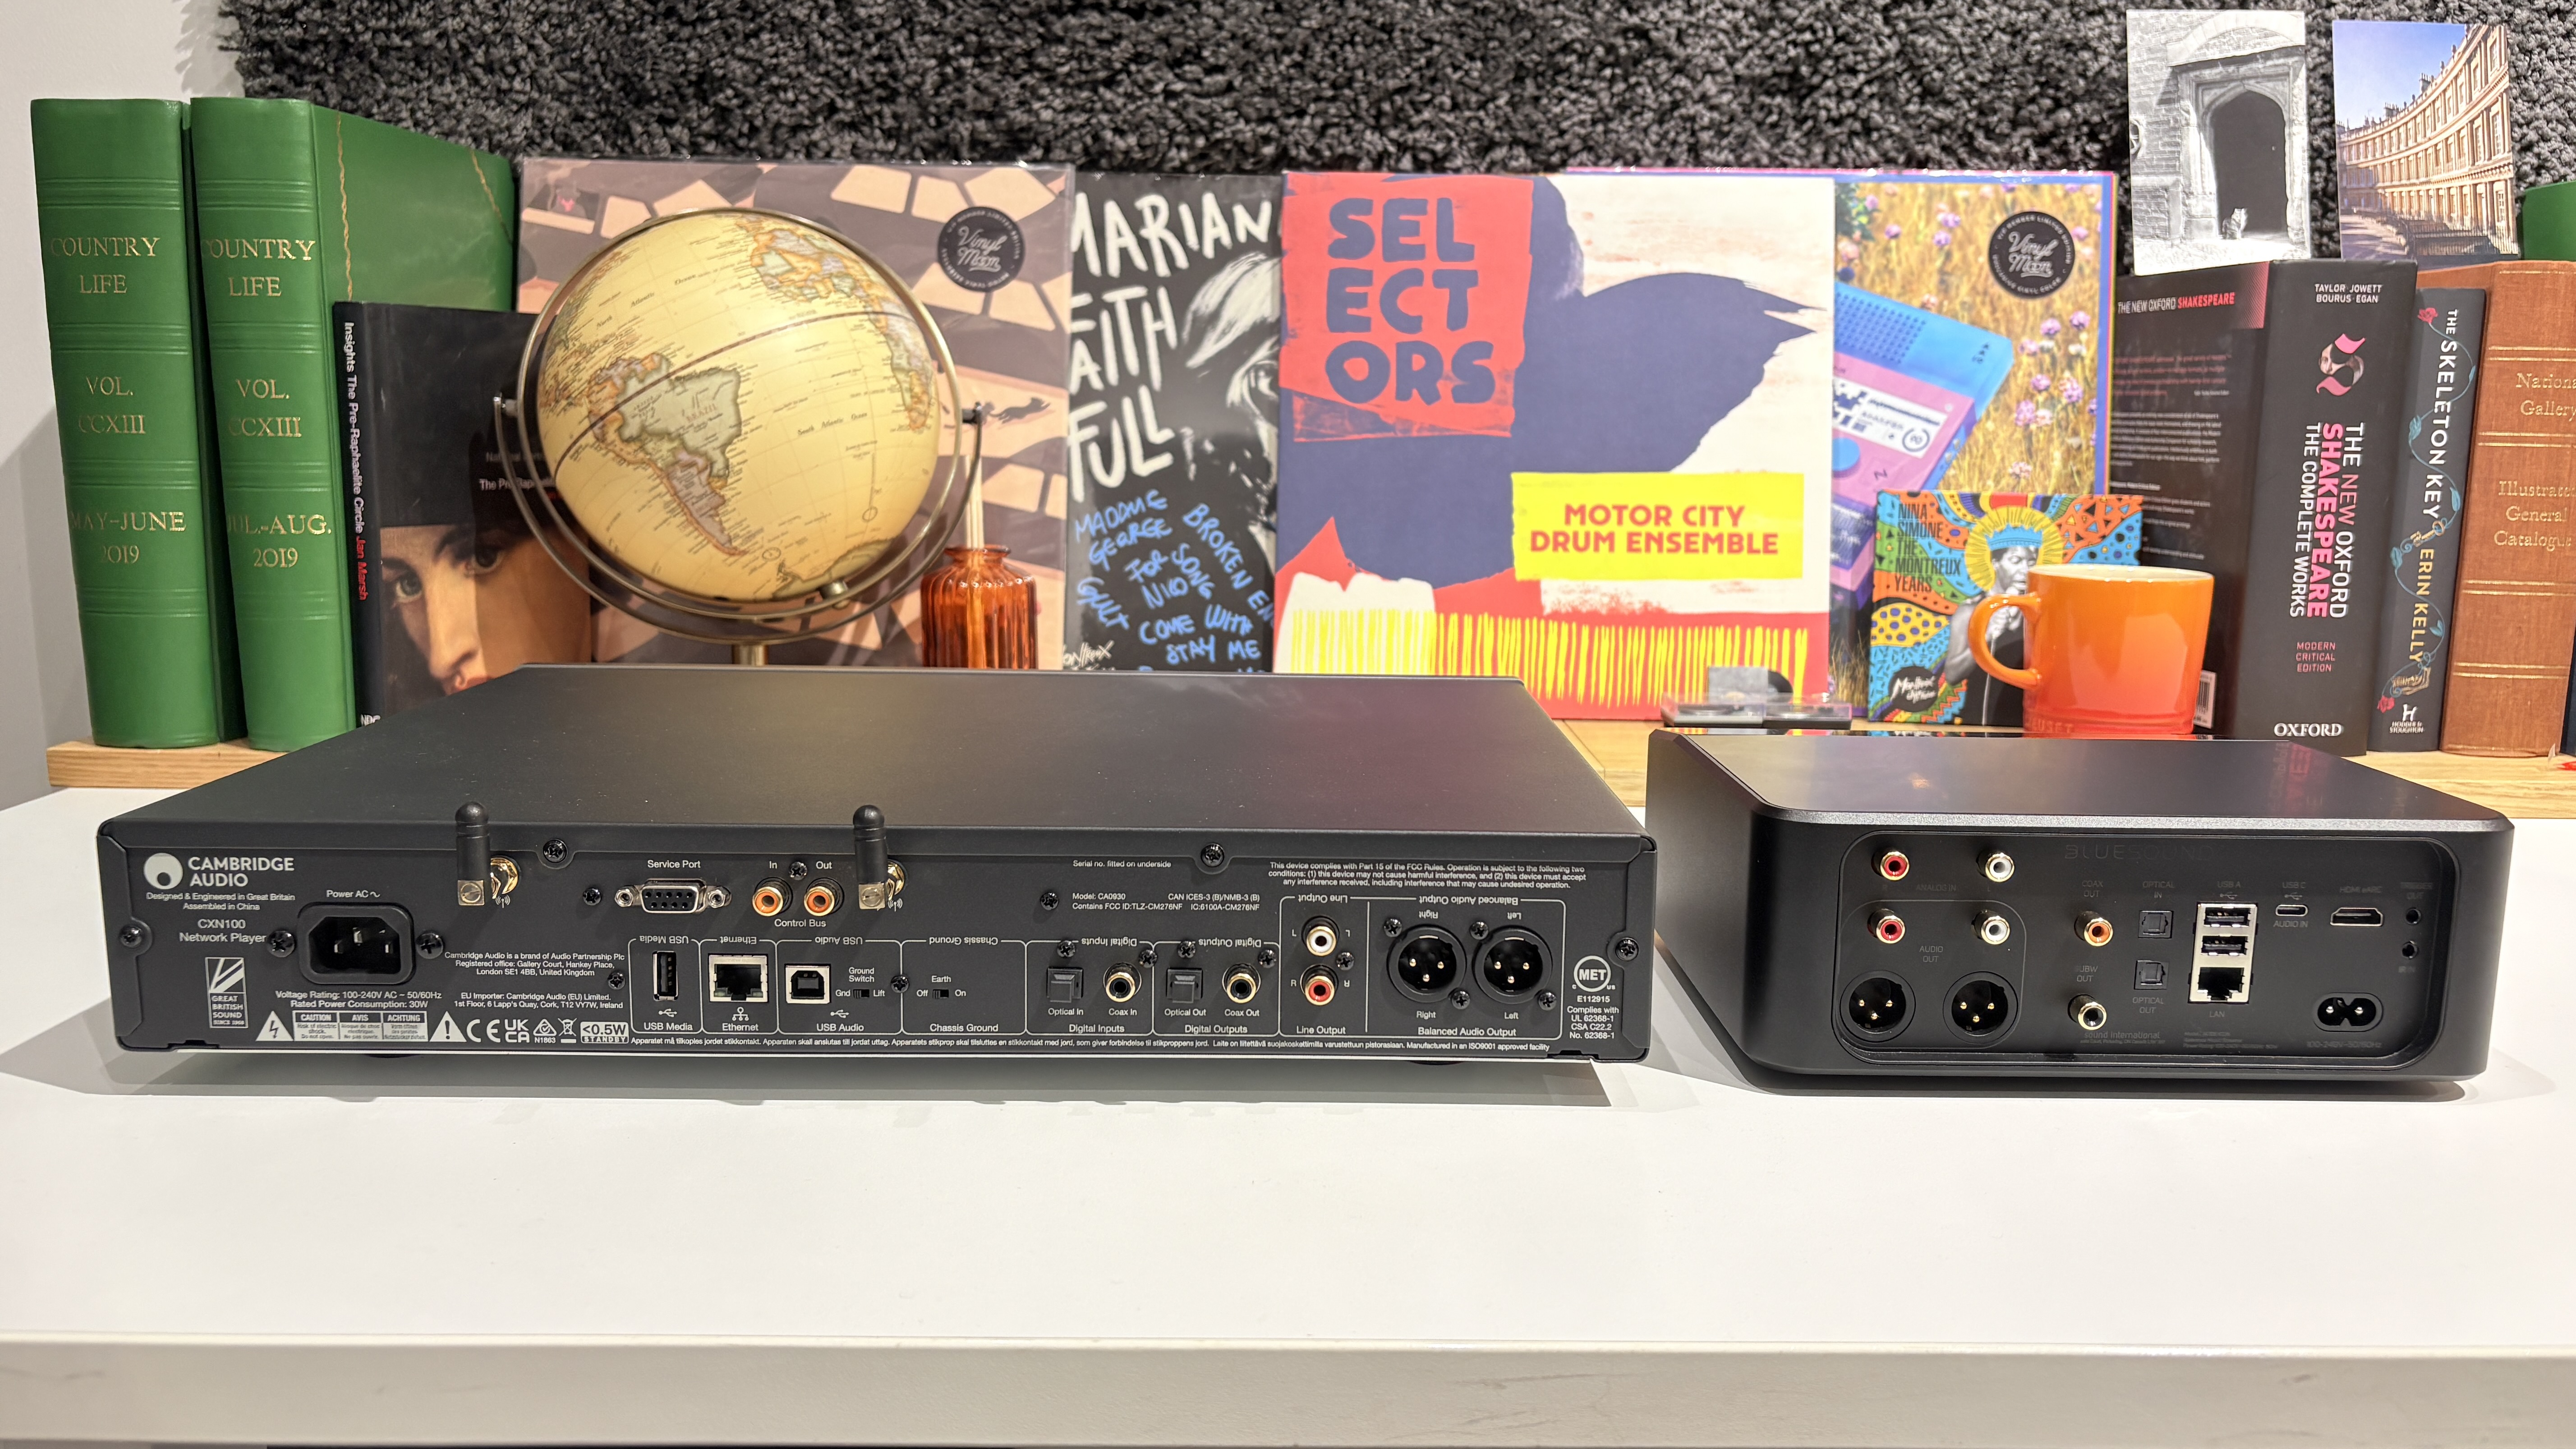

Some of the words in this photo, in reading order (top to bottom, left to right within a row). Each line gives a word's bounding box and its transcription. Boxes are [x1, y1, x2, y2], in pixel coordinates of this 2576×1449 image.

[958, 226, 1008, 255] Vinyl
[1328, 197, 1476, 262] SEL
[2008, 231, 2059, 261] Vinyl
[957, 246, 1001, 272] Moon
[2009, 252, 2054, 278] Moon
[79, 274, 128, 294] LIFE
[228, 276, 281, 297] LIFE
[2314, 284, 2346, 293] TAYLOR
[2350, 284, 2383, 293] JOWETT
[1326, 267, 1478, 334] ECT
[2118, 301, 2130, 314] THE
[2131, 299, 2147, 313] NEW
[2148, 297, 2176, 311] OXFORD
[2177, 292, 2235, 309] SHAKESPEARE
[2316, 294, 2351, 304] BOURUS
[2355, 294, 2378, 304] EGAN
[2446, 309, 2457, 335] THE
[344, 322, 355, 372] Insights
[1325, 340, 1495, 405] ORS
[86, 377, 133, 396] VOL.
[235, 379, 290, 399] VOL.
[347, 375, 357, 400] The
[2429, 340, 2457, 465] SKELETON
[78, 414, 146, 434] CCXIII
[228, 417, 301, 437] CCXIII
[348, 402, 362, 495] Pre-Raphaelite
[1067, 385, 1175, 502] FULL
[2303, 422, 2321, 458] THE
[2342, 422, 2365, 467] THE
[2295, 460, 2317, 552] COMPLETE
[2338, 474, 2358, 525] NEW
[2423, 474, 2443, 519] KEY
[352, 497, 363, 534] Circle
[1564, 504, 1671, 527] MOTOR
[1682, 504, 1745, 527] CITY
[1898, 503, 1927, 521] NINA
[2307, 423, 2343, 618] SHAKESPEARE
[2506, 506, 2568, 522] General
[1897, 521, 1943, 538] SIMONE
[356, 536, 366, 559] Jan
[1088, 517, 1173, 572] GEORGE
[1183, 503, 1253, 590] BROKEN
[1529, 531, 1616, 554] DRUM
[1626, 531, 1779, 555] ENSEMBLE
[1896, 540, 1918, 557] THE
[100, 546, 139, 564] 2019
[253, 547, 298, 567] 2019
[1895, 557, 1961, 575] MONTREUX
[358, 562, 368, 600] Marsh
[1173, 543, 1215, 600] SONG
[2329, 532, 2354, 618] OXFORD
[2416, 549, 2434, 595] ERIN
[1894, 575, 1931, 593] YEARS
[2289, 556, 2309, 617] WORKS
[1139, 615, 1196, 644] COME
[1205, 603, 1253, 636] WITH
[2409, 603, 2429, 662] KELLY
[1166, 635, 1215, 665] STAY
[1228, 639, 1261, 662] ME
[2297, 642, 2335, 650] MODERN
[2296, 653, 2335, 662] CRITICAL
[2297, 664, 2332, 672] EDITION
[2274, 723, 2343, 737] OXFORD
[189, 857, 294, 870] CAMBRIDGE
[190, 874, 248, 886] AUDIO
[198, 919, 245, 928] CXN100
[180, 933, 228, 942] Network
[231, 933, 266, 944] Player
[445, 952, 483, 961] Cambridge
[572, 953, 612, 961] Partnership
[849, 967, 874, 975] Ground
[1578, 968, 1606, 980] MET
[1049, 1008, 1074, 1016] Optical
[582, 1024, 627, 1036] <0.5W
[1069, 1024, 1095, 1034] Digital
[1097, 1025, 1126, 1034] Inputs
[1185, 1025, 1210, 1034] Digital
[1214, 1025, 1249, 1035] Outputs
[1317, 1026, 1345, 1035] Output
[1418, 1027, 1457, 1037] Balanced
[1487, 1028, 1516, 1037] Output
